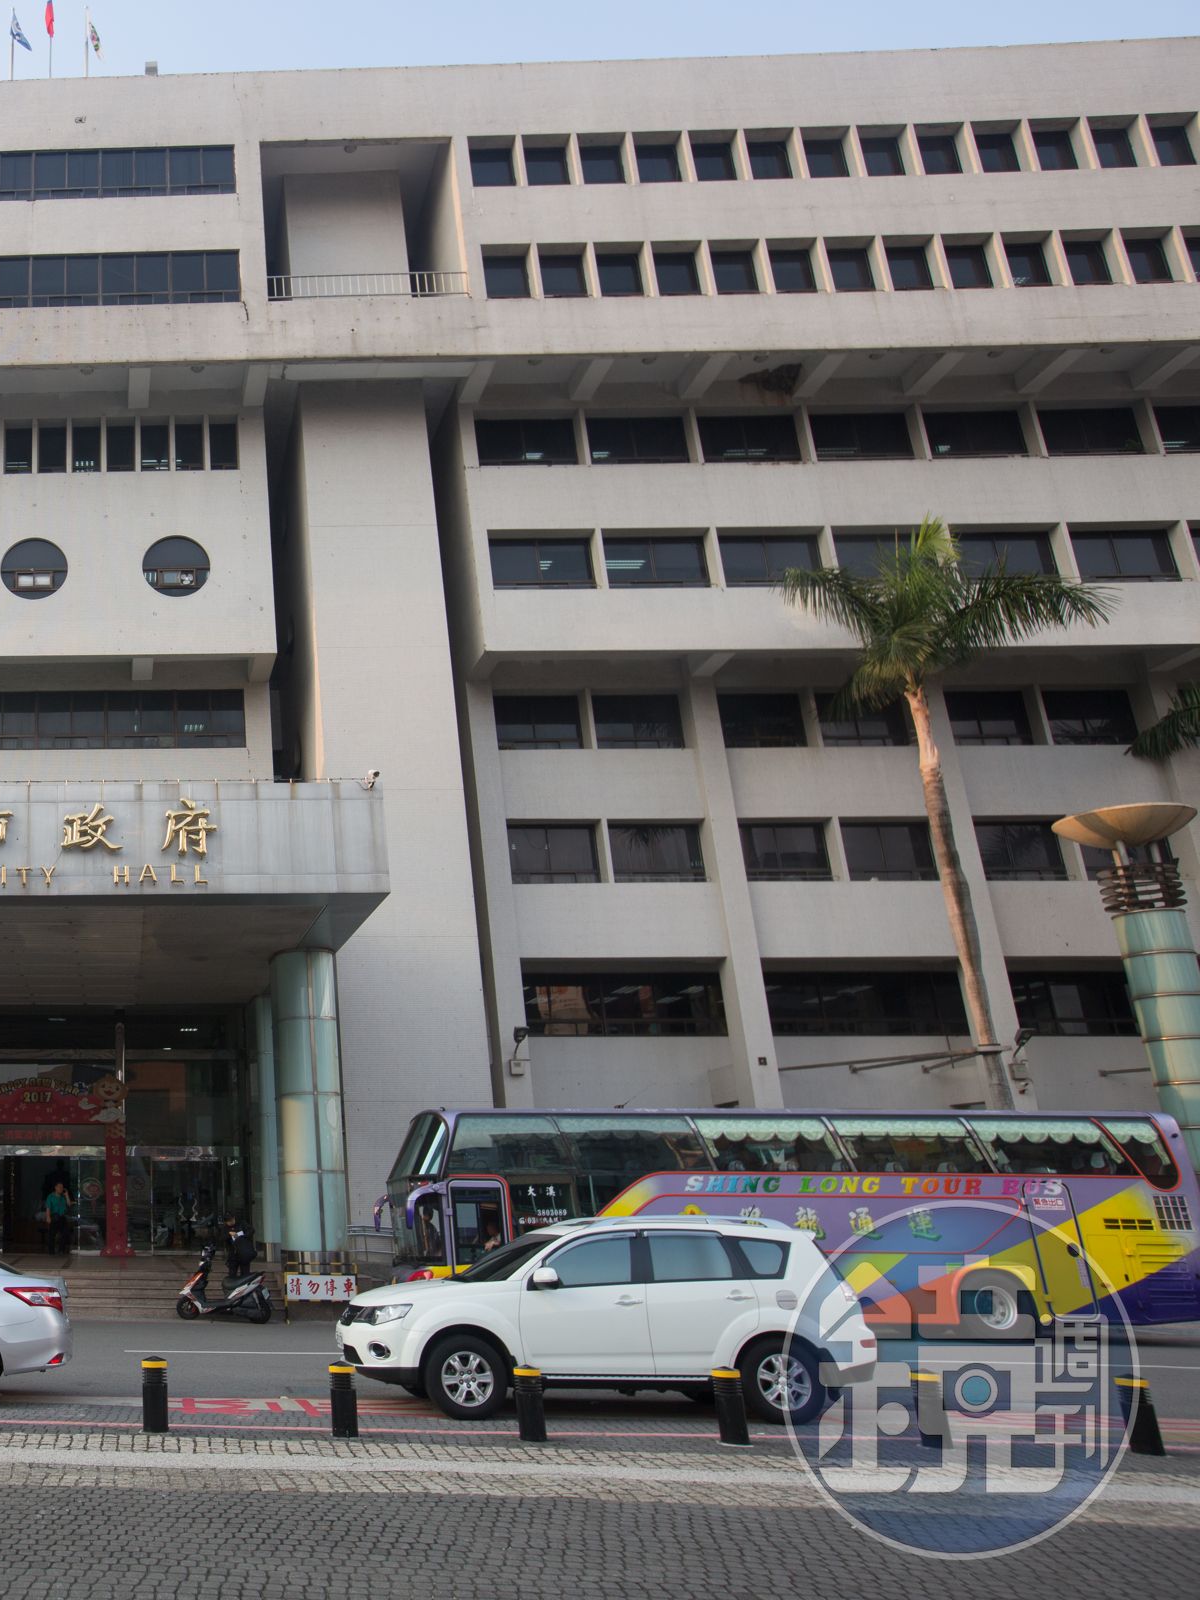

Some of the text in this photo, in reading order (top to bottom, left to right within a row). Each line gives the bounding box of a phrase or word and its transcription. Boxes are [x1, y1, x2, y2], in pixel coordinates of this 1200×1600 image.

[113, 864, 209, 887] HALL
[23, 1091, 52, 1103] 2017
[684, 1175, 1063, 1196] SHING LONG TOUR BUS
[1033, 1198, 1064, 1207] 緊急出口
[289, 1277, 354, 1297] 請勿停車
